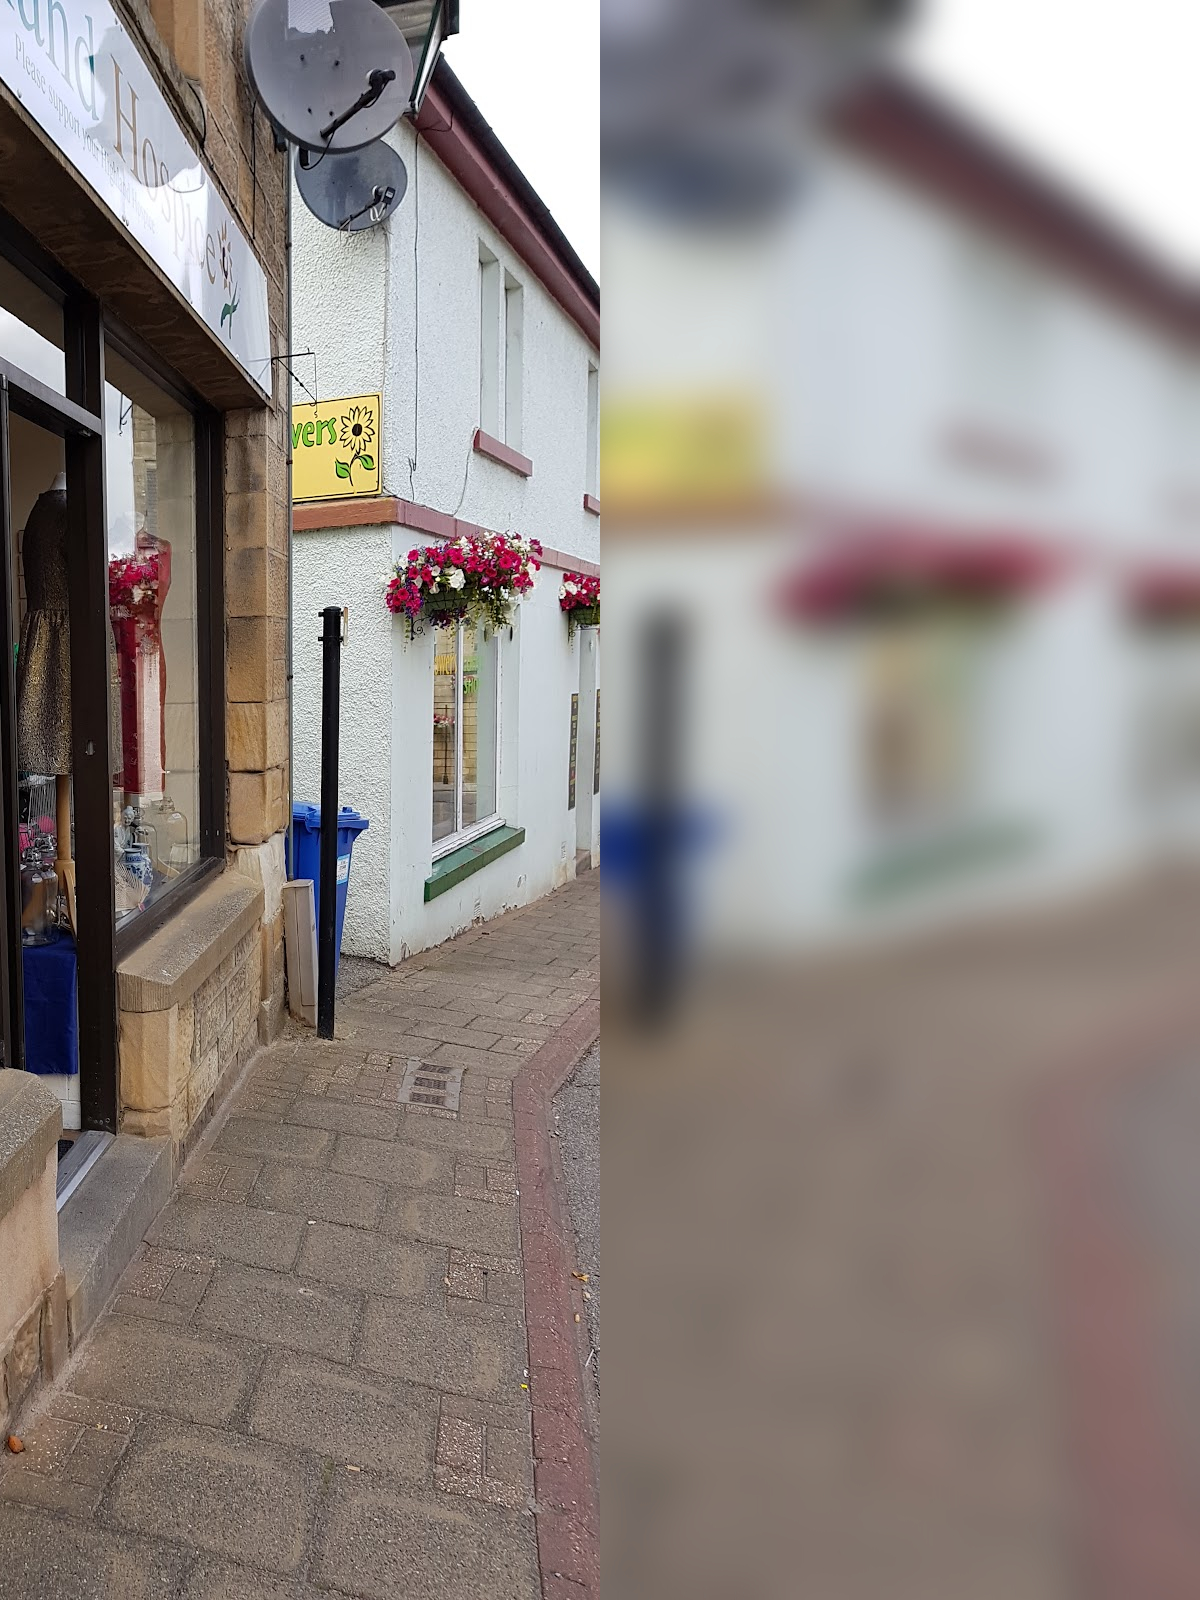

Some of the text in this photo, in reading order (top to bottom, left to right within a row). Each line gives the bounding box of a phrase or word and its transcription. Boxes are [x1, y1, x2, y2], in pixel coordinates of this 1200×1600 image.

[7, 0, 217, 285] and Hospice
[15, 32, 46, 95] Please
[48, 85, 81, 139] support
